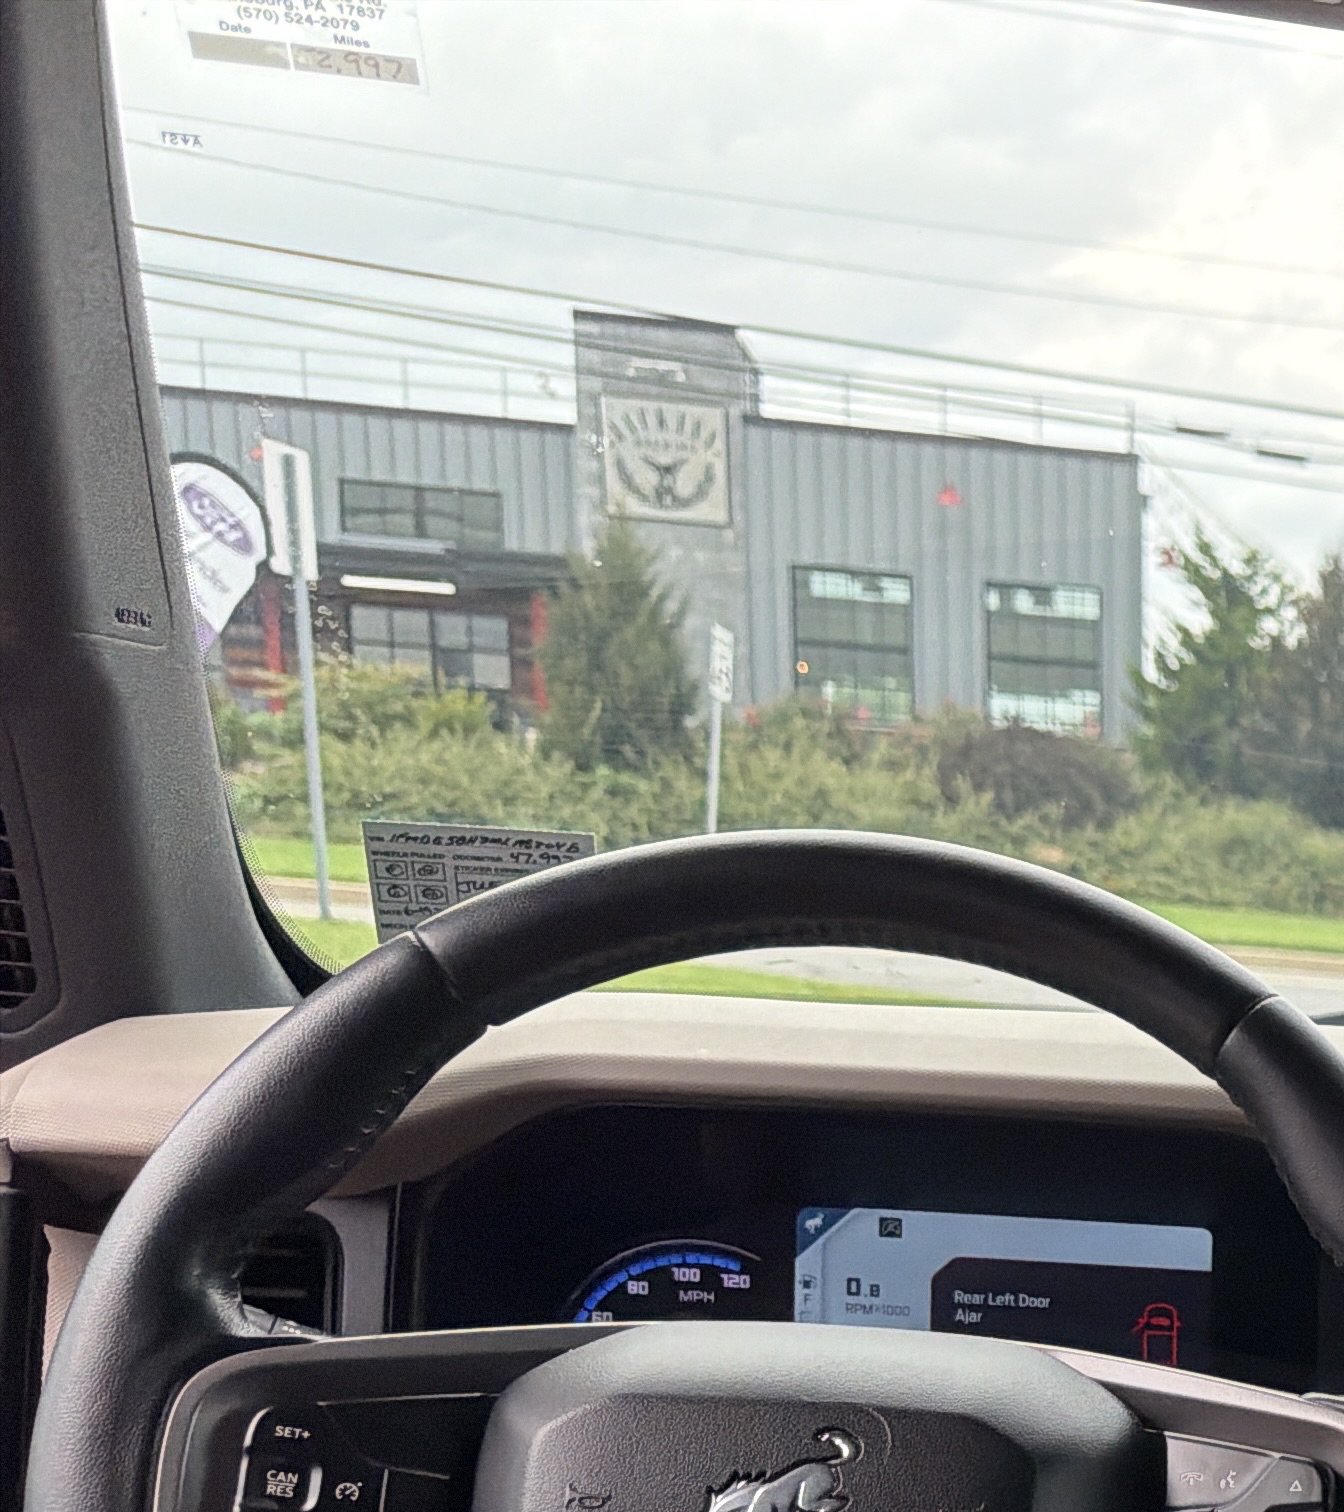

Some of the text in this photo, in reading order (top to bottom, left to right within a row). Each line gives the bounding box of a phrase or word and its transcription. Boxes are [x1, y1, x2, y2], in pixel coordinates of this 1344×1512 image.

[237, 5, 279, 24] (570)
[283, 11, 360, 31] 524-2079
[337, 3, 385, 20] 17837
[219, 20, 251, 33] Date
[333, 34, 370, 49] Miles
[671, 1267, 700, 1282] 100
[720, 1274, 750, 1290] 120
[627, 1281, 648, 1296] 80
[679, 1290, 714, 1304] MPH
[954, 1289, 1051, 1309] Rear Left Door
[954, 1307, 982, 1325] Ajar
[274, 1425, 312, 1440] SET+
[266, 1469, 298, 1484] CAN
[266, 1483, 294, 1498] RES
